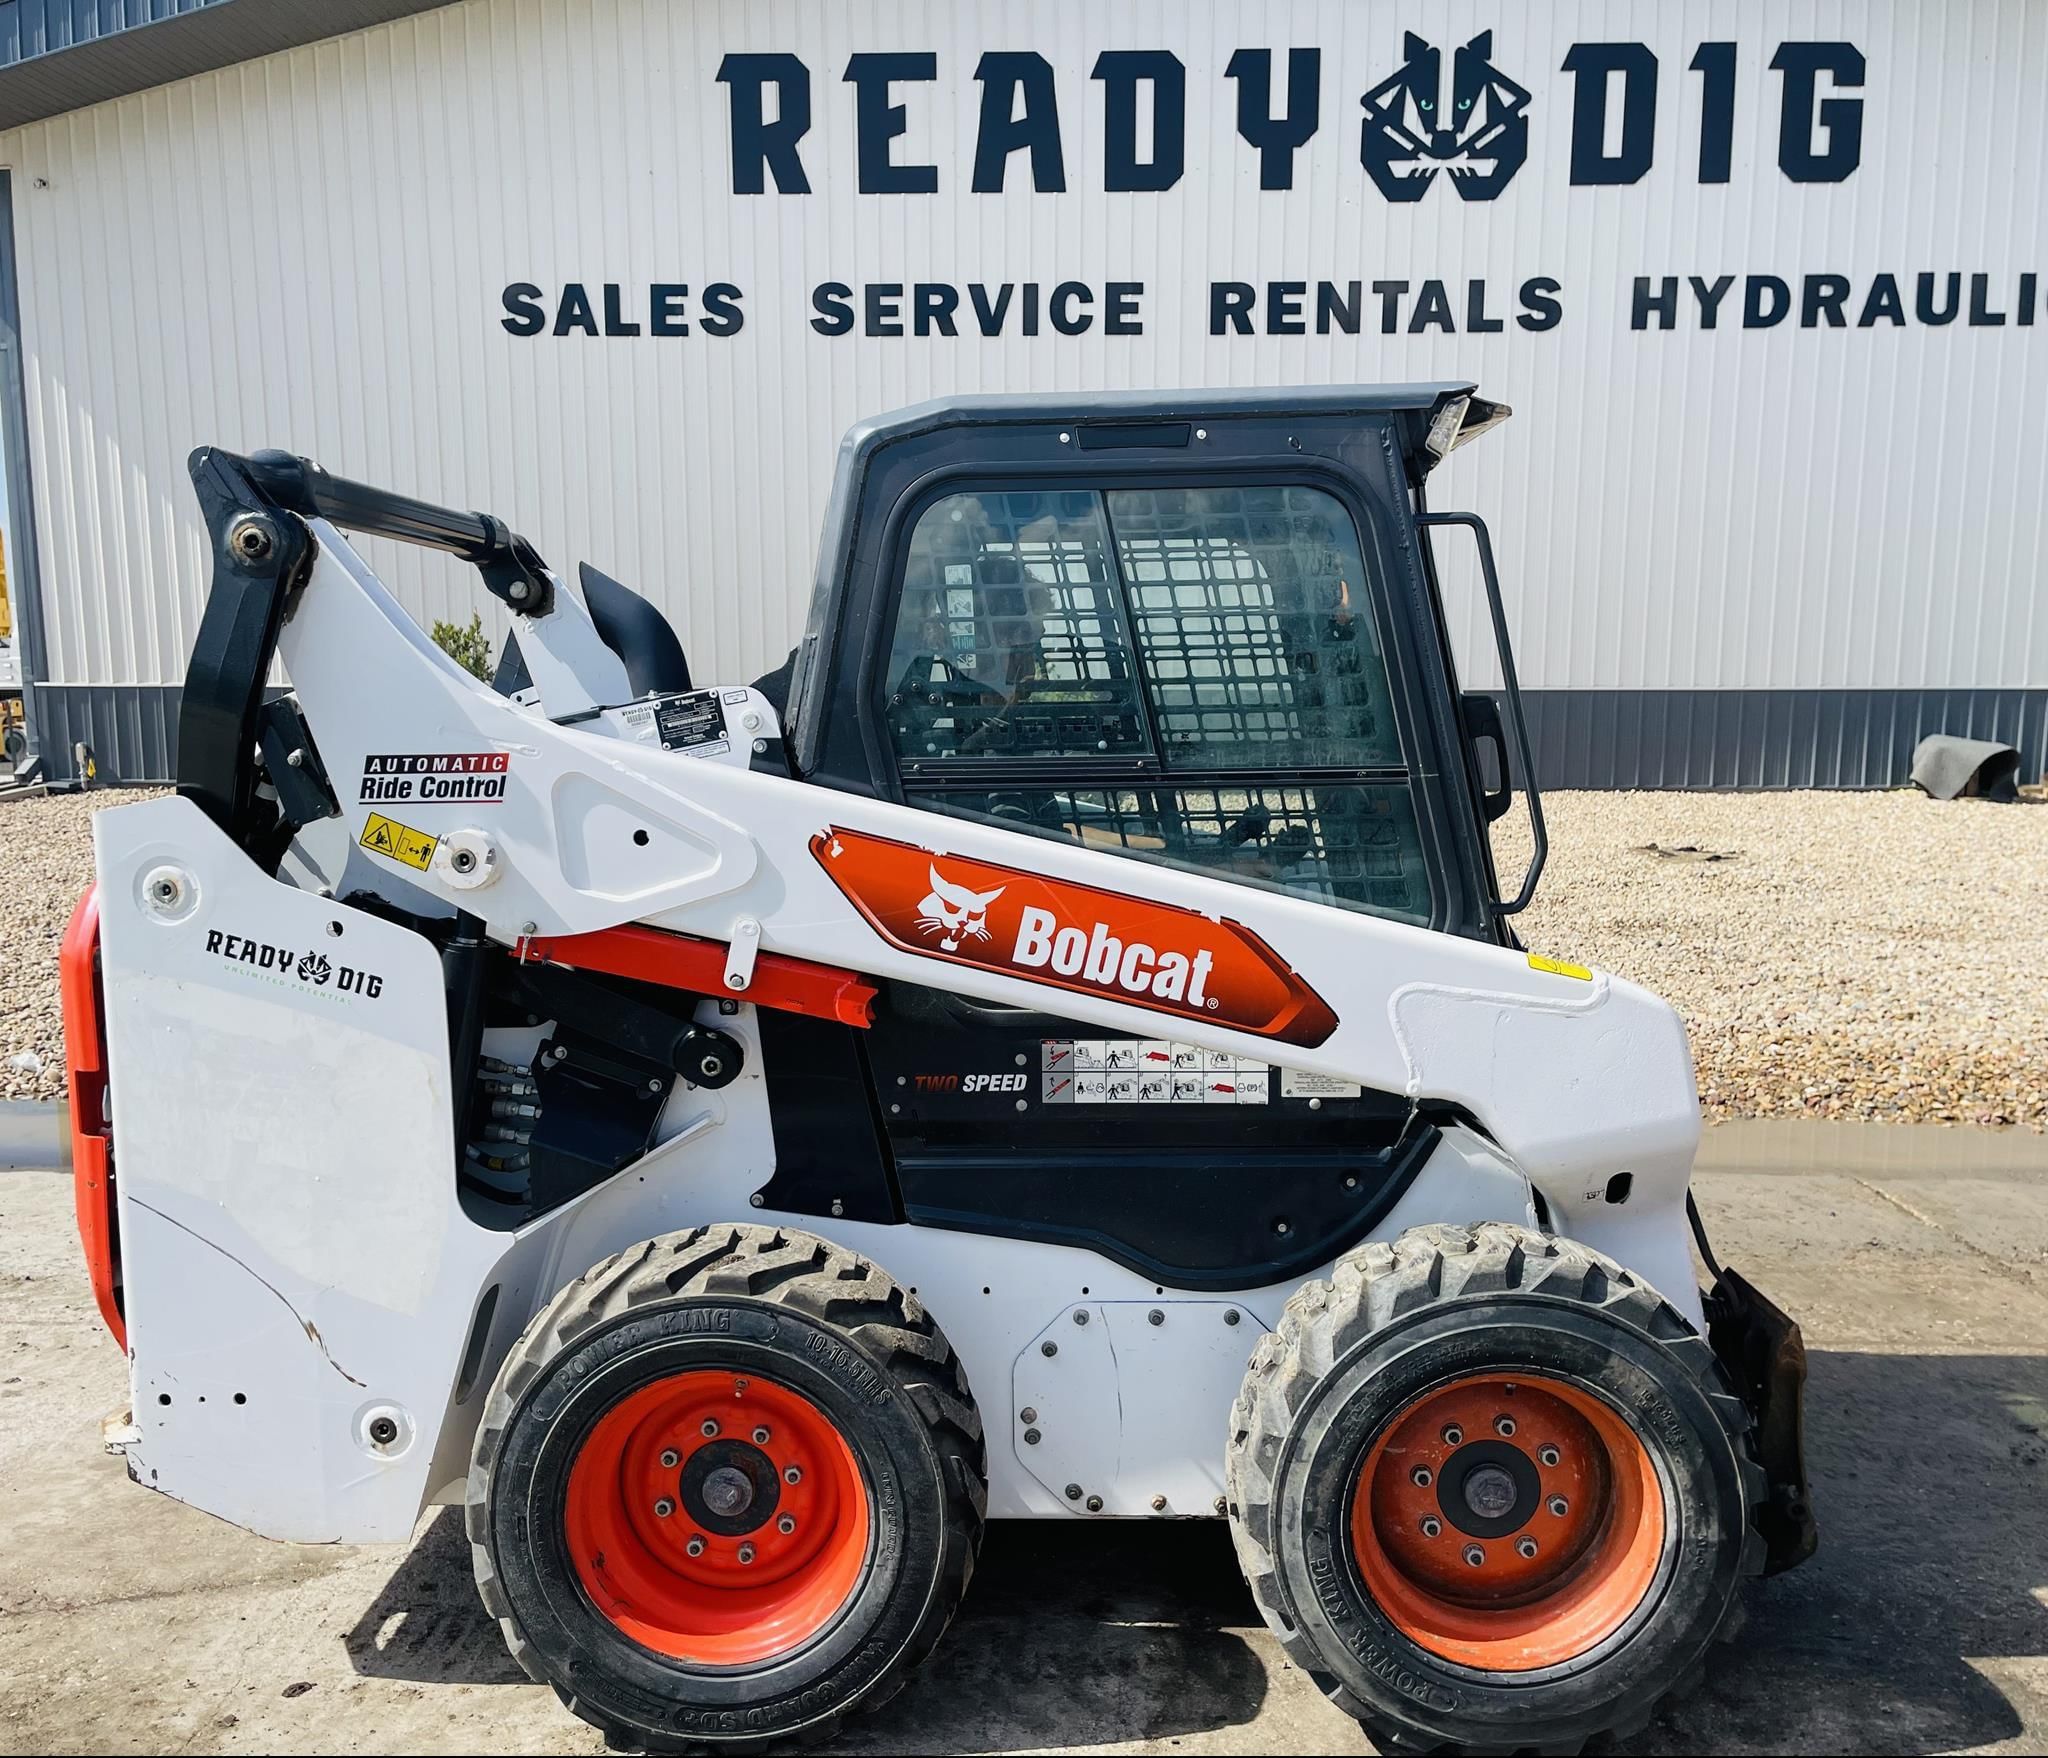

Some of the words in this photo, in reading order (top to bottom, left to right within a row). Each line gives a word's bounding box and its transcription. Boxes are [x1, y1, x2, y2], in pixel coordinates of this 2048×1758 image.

[715, 48, 1320, 194] READY
[1561, 42, 1866, 186] DIG
[501, 283, 743, 337] SALES
[810, 282, 1143, 336] SERVICE
[1210, 277, 1562, 335] RENTALS
[1631, 272, 2048, 331] HYDRAULI
[359, 776, 413, 799] Ride
[419, 775, 507, 798] Control
[369, 756, 504, 773] AUTOMATIC
[205, 929, 295, 973] READY
[336, 966, 384, 999] DIG
[223, 964, 285, 987] UNLIMITED
[1012, 905, 1214, 1007] Bobcat
[914, 1075, 958, 1092] TWO
[962, 1074, 1028, 1092] SPEED
[557, 1324, 646, 1391] POWER
[660, 1309, 731, 1337] KING
[1309, 1556, 1349, 1623] KING
[1346, 1628, 1430, 1702] POWER
